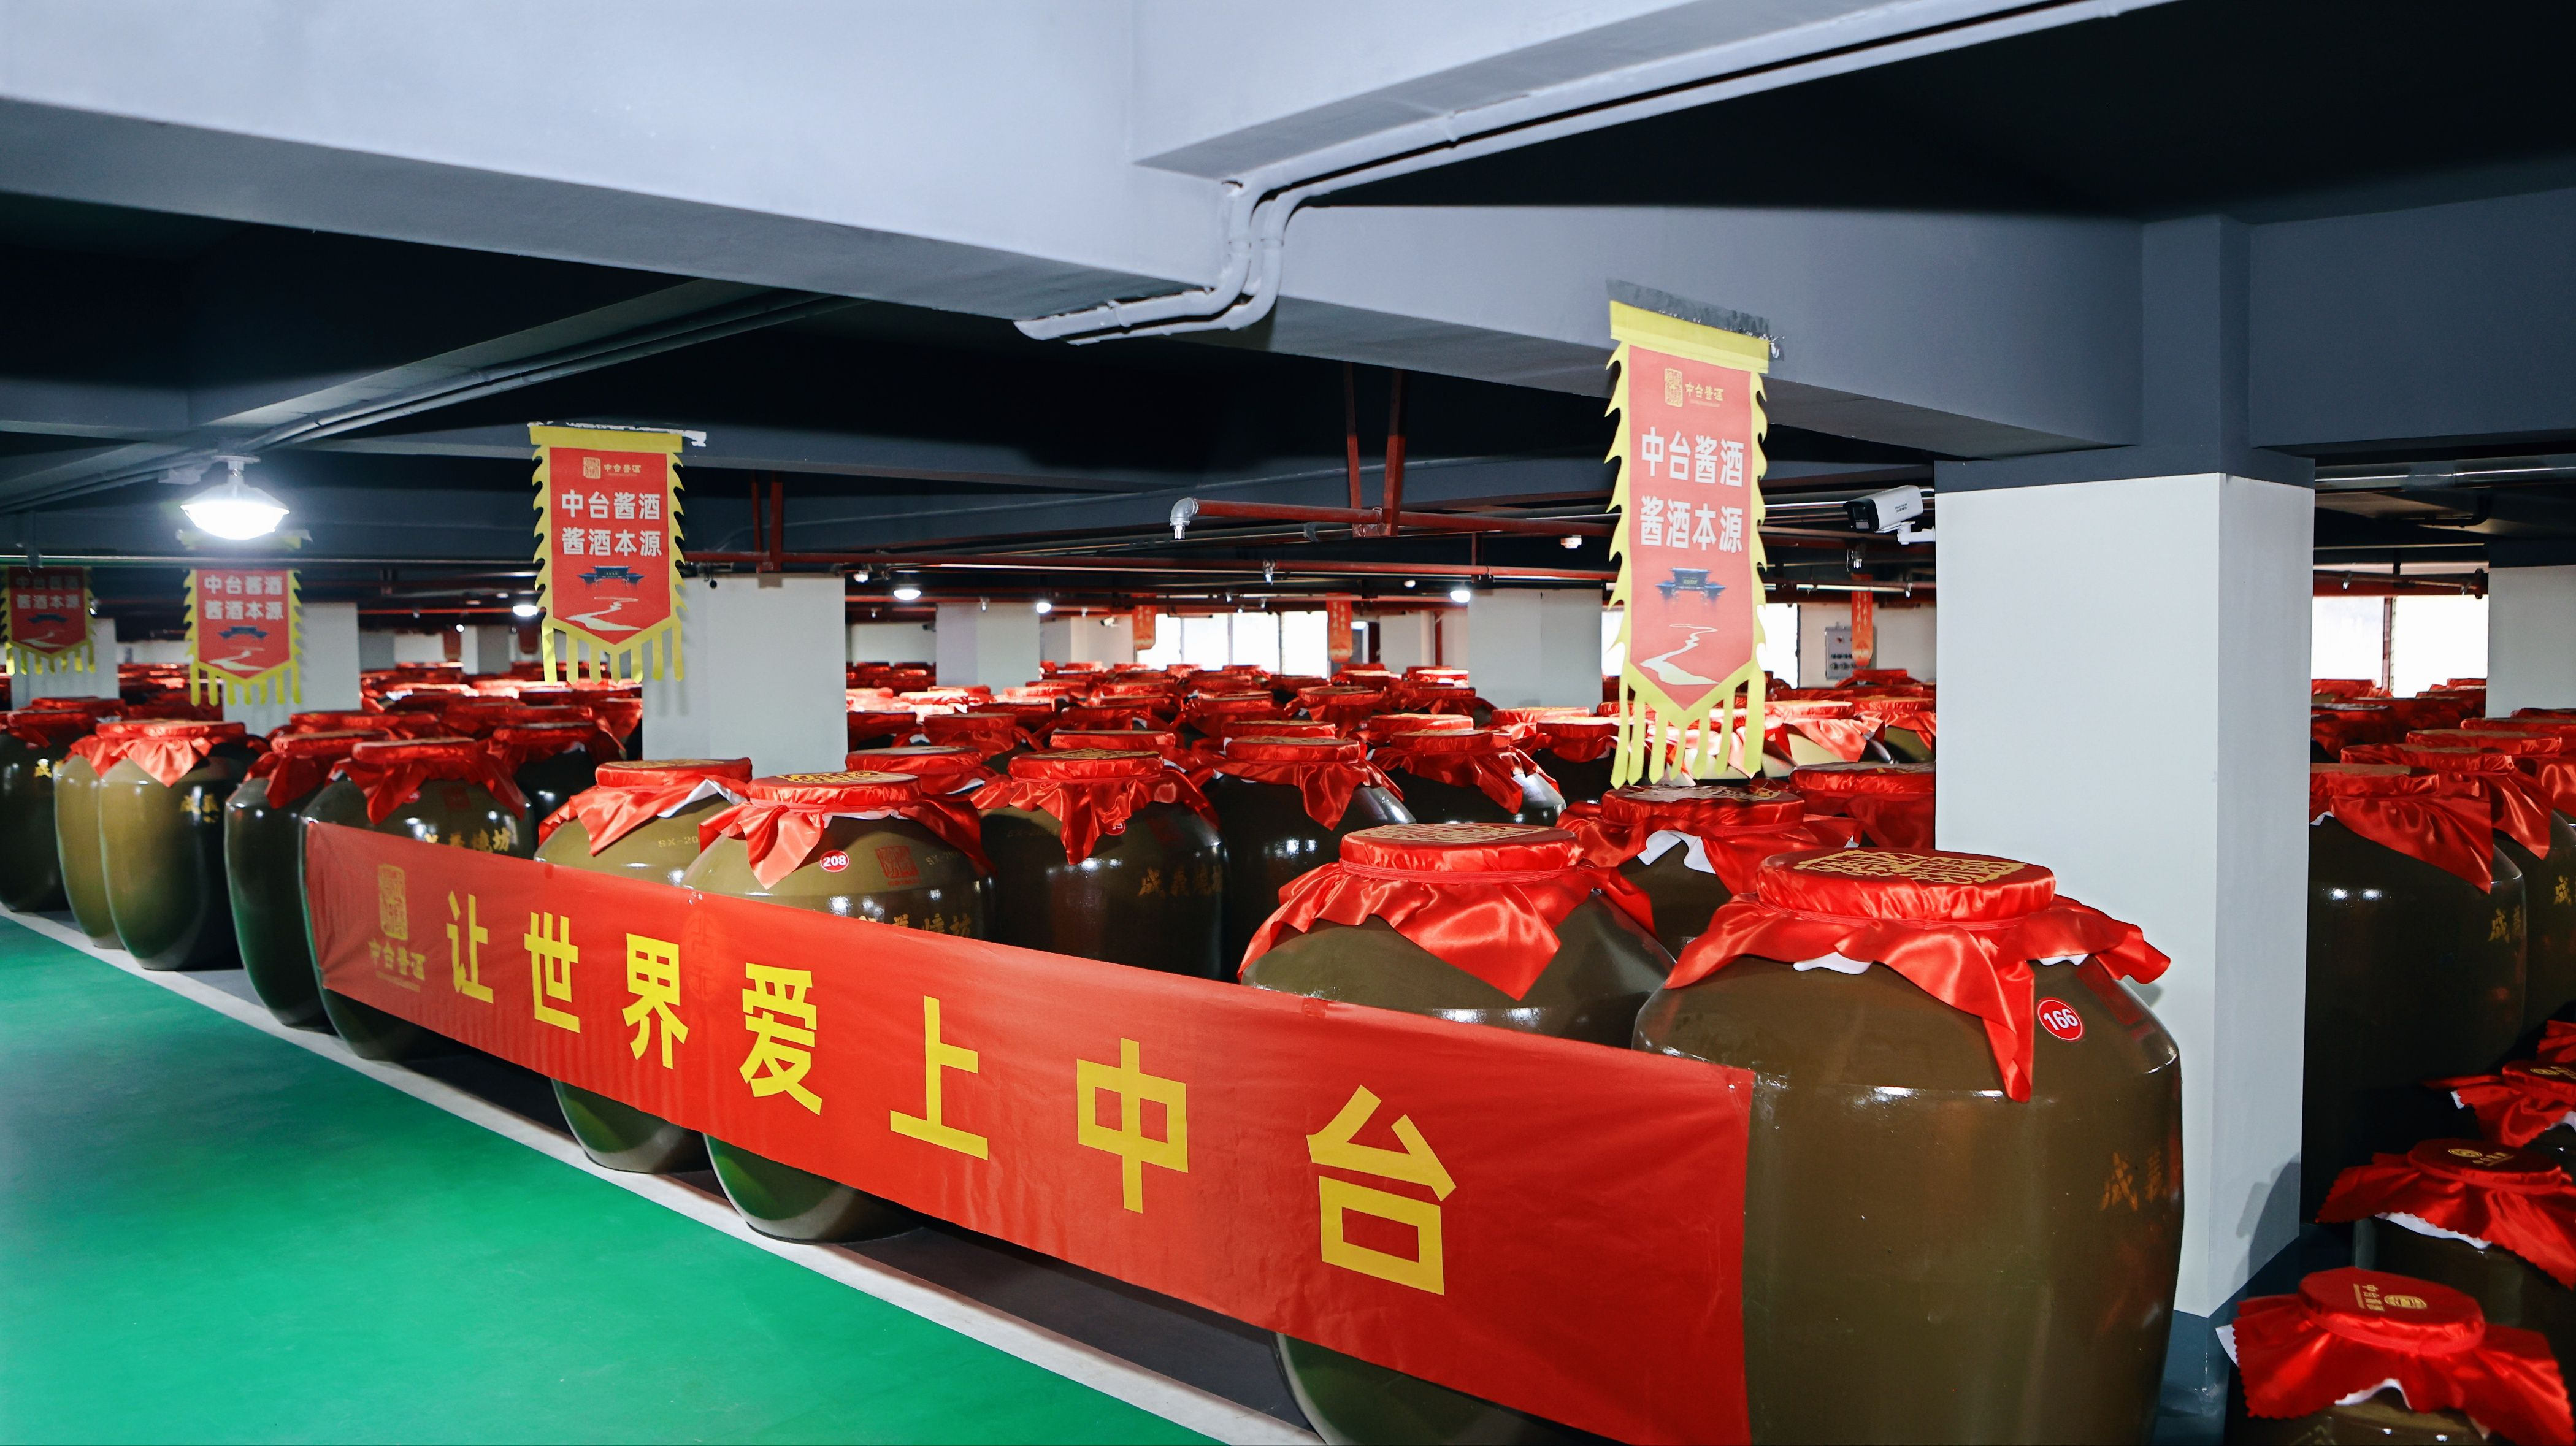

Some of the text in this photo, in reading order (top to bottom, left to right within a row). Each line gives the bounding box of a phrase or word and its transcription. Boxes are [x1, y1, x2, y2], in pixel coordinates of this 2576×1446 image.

[1641, 426, 1744, 487] 中台酱酒
[561, 489, 661, 520] 中台酱酒
[1640, 495, 1743, 553] 酱酒本源
[562, 527, 662, 557] 酱酒本源
[204, 574, 283, 595] 中台酱酒
[205, 600, 284, 621] 酱酒本源
[822, 855, 847, 868] 208
[2043, 1008, 2079, 1031] 166
[447, 890, 1456, 1295] 让世界爱上中台
